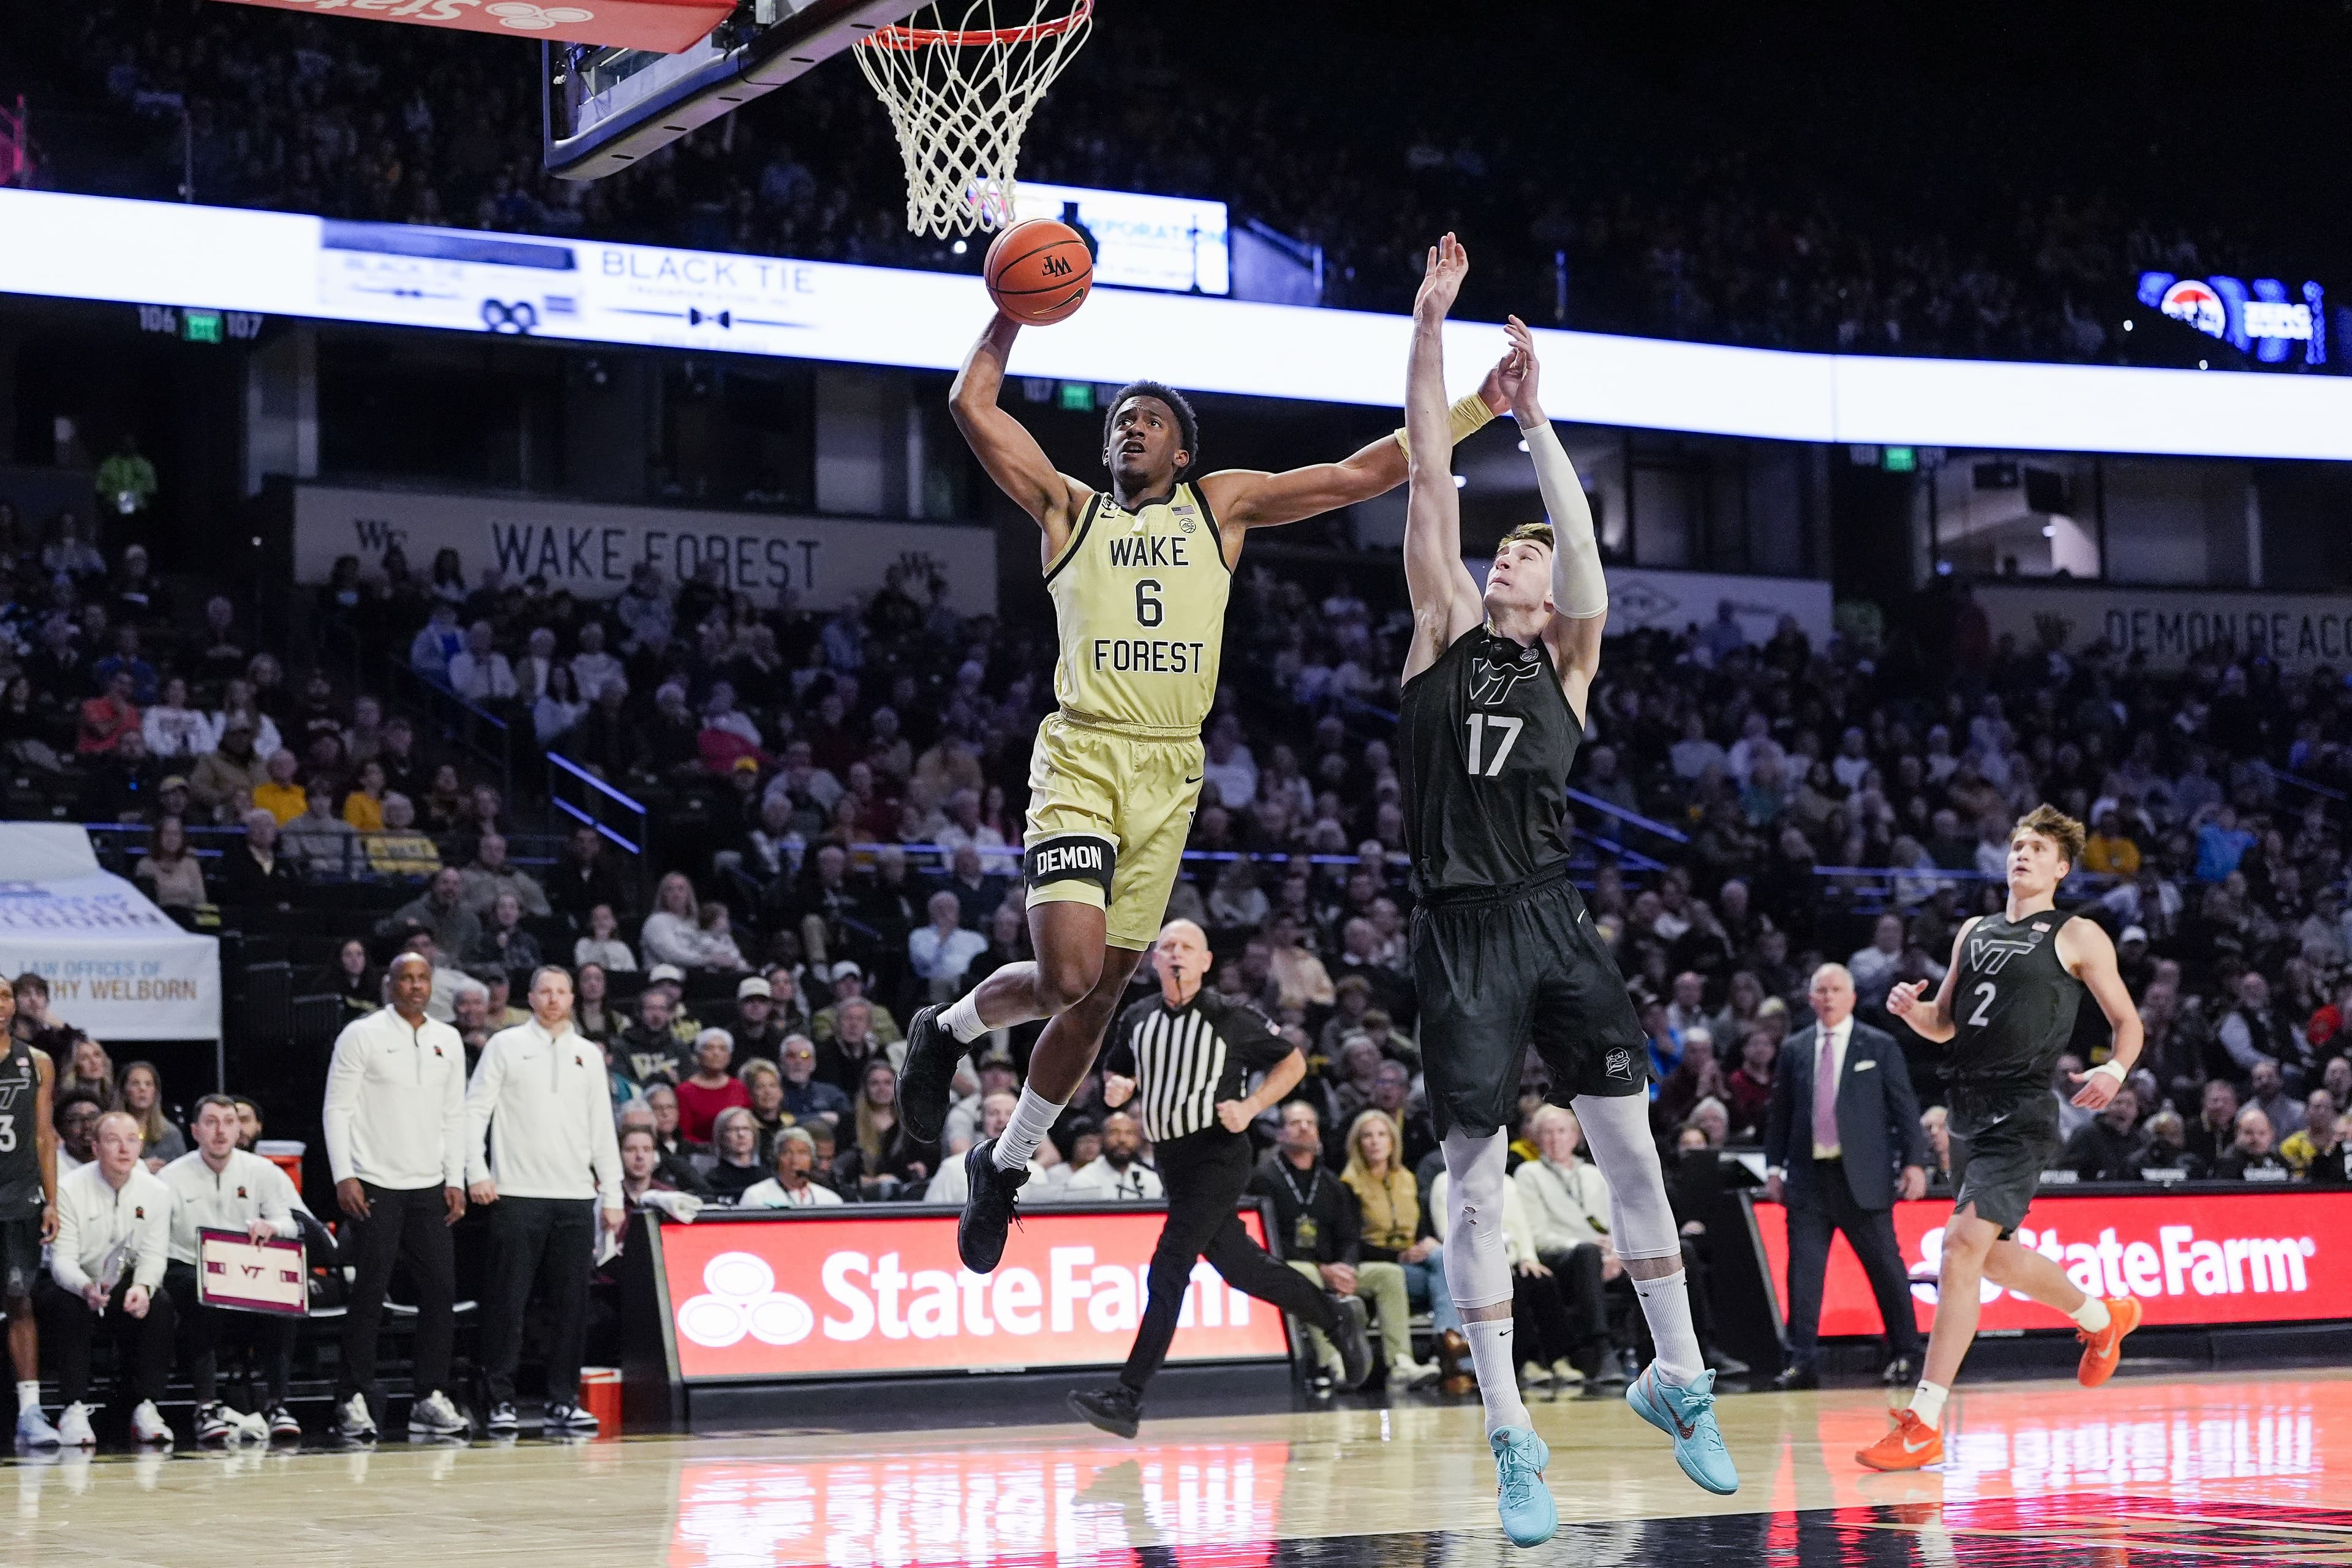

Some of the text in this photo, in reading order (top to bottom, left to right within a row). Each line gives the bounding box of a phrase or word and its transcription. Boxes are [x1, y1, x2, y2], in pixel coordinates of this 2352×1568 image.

[602, 250, 816, 294] BLACK TIE
[492, 522, 821, 590] WAKE FOREST
[1109, 535, 1189, 567] WAKE
[1135, 578, 1164, 628] 6
[2246, 610, 2352, 657] DEAC
[1095, 639, 1204, 674] FOREST
[1469, 657, 1542, 705] VT
[1465, 713, 1523, 776] 17
[1037, 845, 1102, 876] DEMON
[64, 960, 136, 977] OFFICES
[1970, 938, 2036, 975] VT
[47, 979, 197, 1001] HY WELBORN
[1968, 981, 1996, 1027] 2
[0, 1077, 31, 1110] T
[240, 1263, 265, 1280] VT
[2009, 1225, 2308, 1302] tateFarm
[821, 1246, 1250, 1341] StateFam
